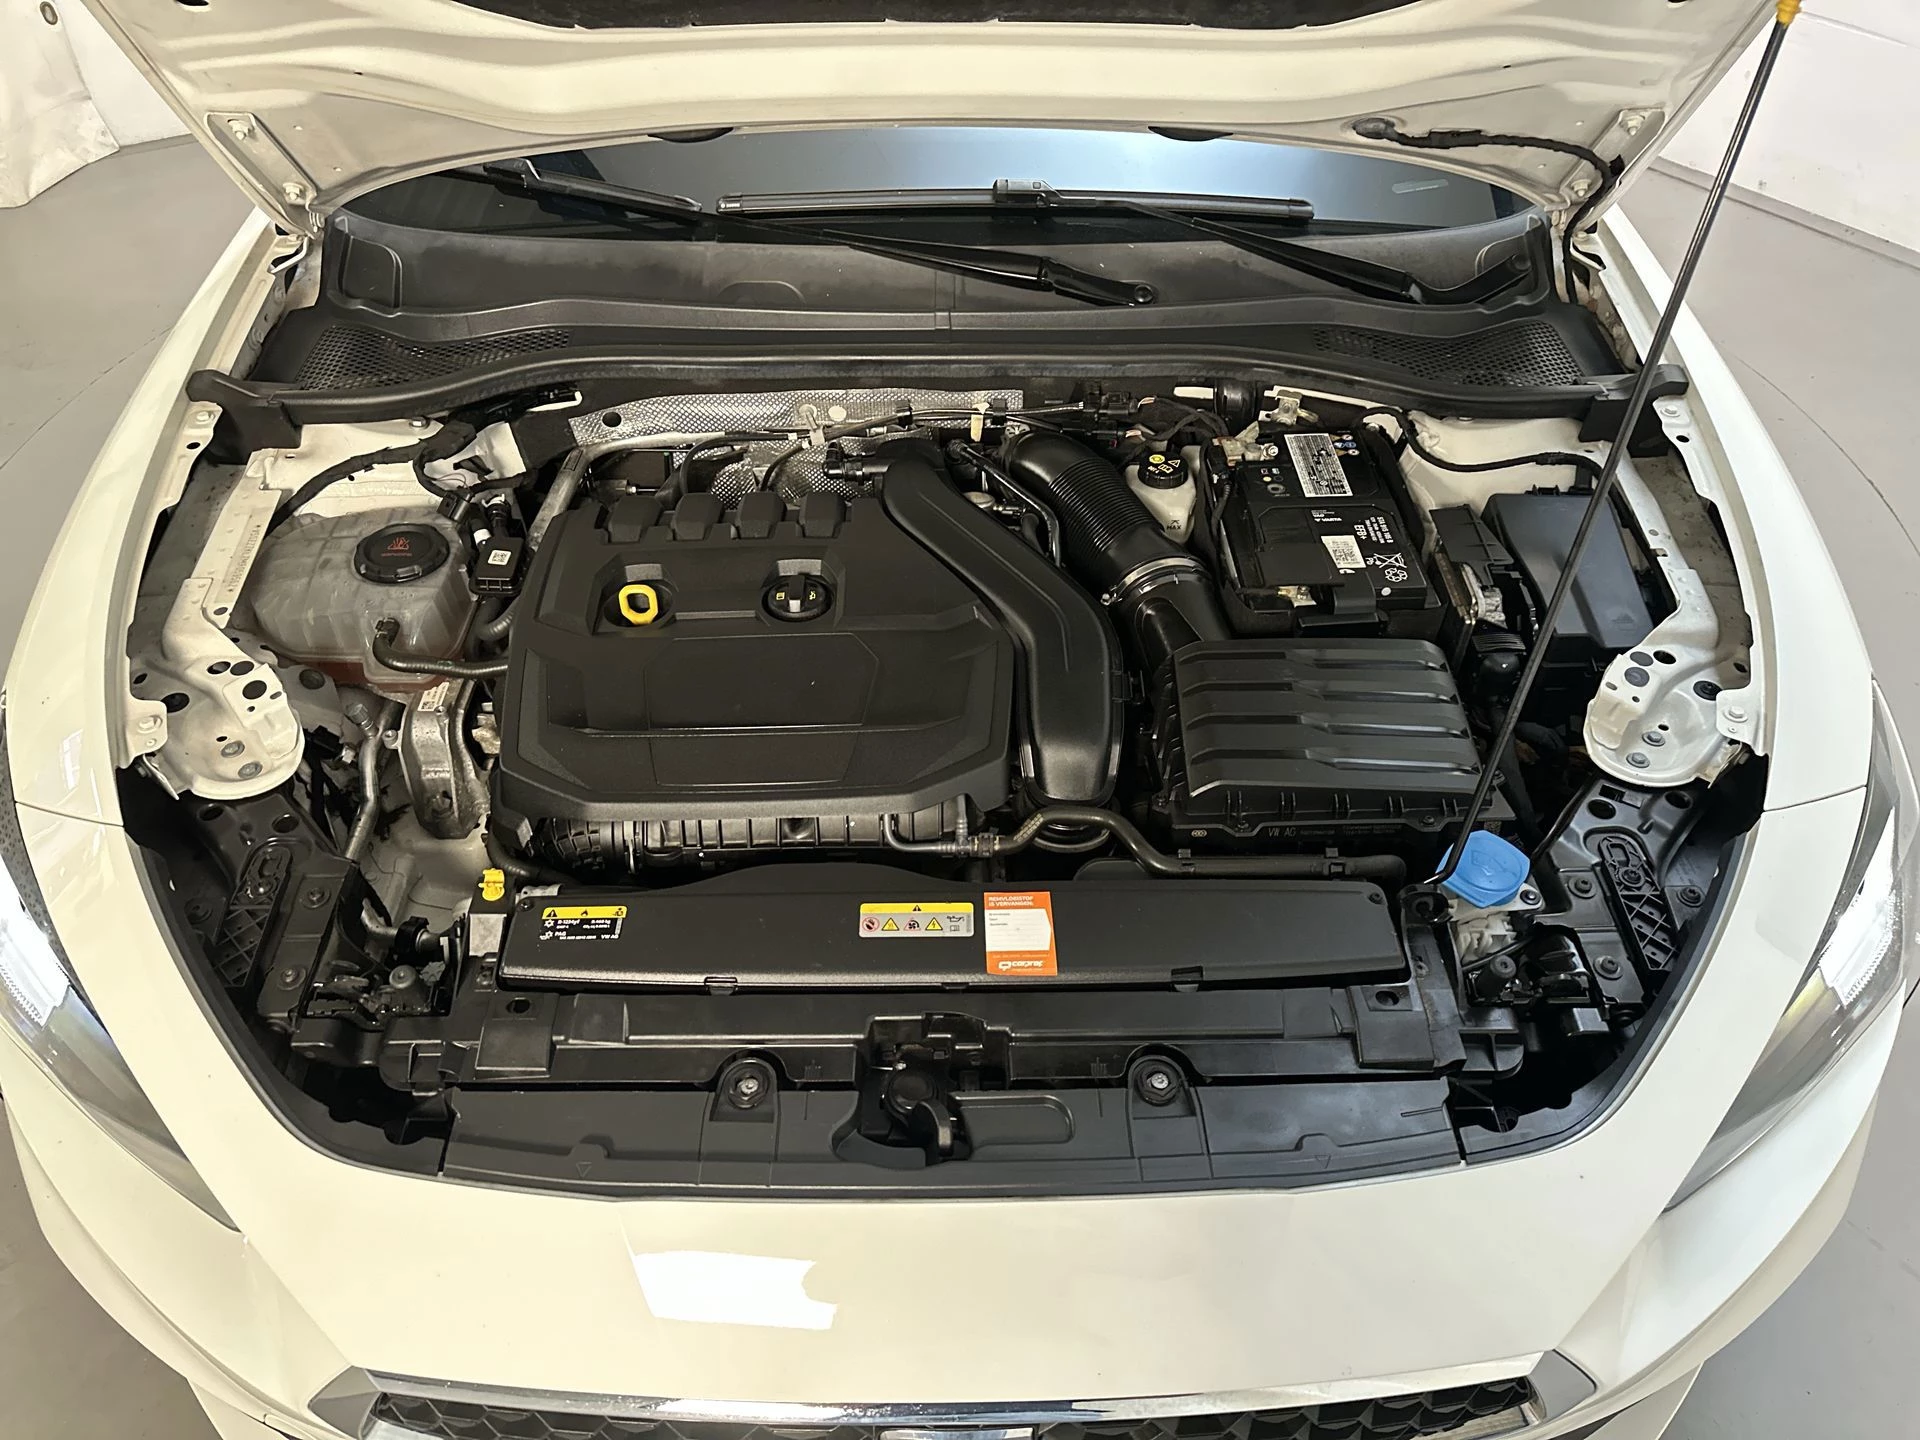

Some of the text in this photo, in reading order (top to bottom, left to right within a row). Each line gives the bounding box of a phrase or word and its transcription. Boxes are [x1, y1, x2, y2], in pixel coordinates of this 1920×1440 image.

[1354, 525, 1367, 539] EFB+
[1365, 557, 1375, 565] Pb
[1268, 827, 1280, 837] VW
[1285, 827, 1296, 837] AG
